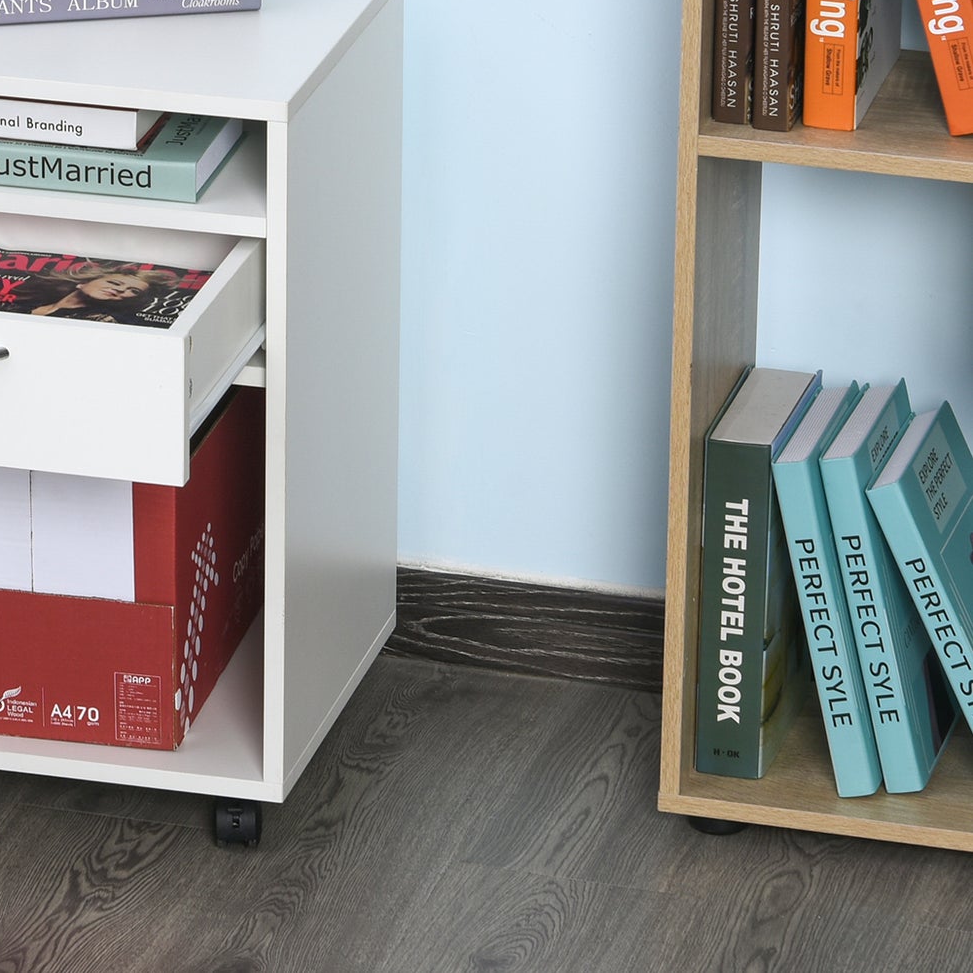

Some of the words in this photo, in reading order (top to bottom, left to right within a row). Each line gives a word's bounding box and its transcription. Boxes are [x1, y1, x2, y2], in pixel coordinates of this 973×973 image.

[769, 4, 780, 52] SHRUTI
[727, 49, 737, 108] HAASAN
[768, 59, 779, 117] HAASAN
[27, 117, 83, 137] Branding
[918, 447, 939, 485] EXPLORE
[925, 480, 938, 502] THE
[934, 452, 954, 487] PERFECT
[723, 498, 749, 551] THE
[933, 492, 948, 520] STYLE
[720, 556, 748, 642] HOTEL
[905, 557, 972, 671] PERFECT
[794, 537, 838, 657] PERFECT
[821, 664, 854, 728] SYLE
[841, 534, 886, 654] PERFECT
[869, 661, 900, 725] SYLE
[132, 676, 152, 685] APP
[717, 649, 743, 724] BOOK
[7, 705, 34, 714] LEGAL
[50, 703, 73, 719] A4
[77, 706, 99, 722] 70
